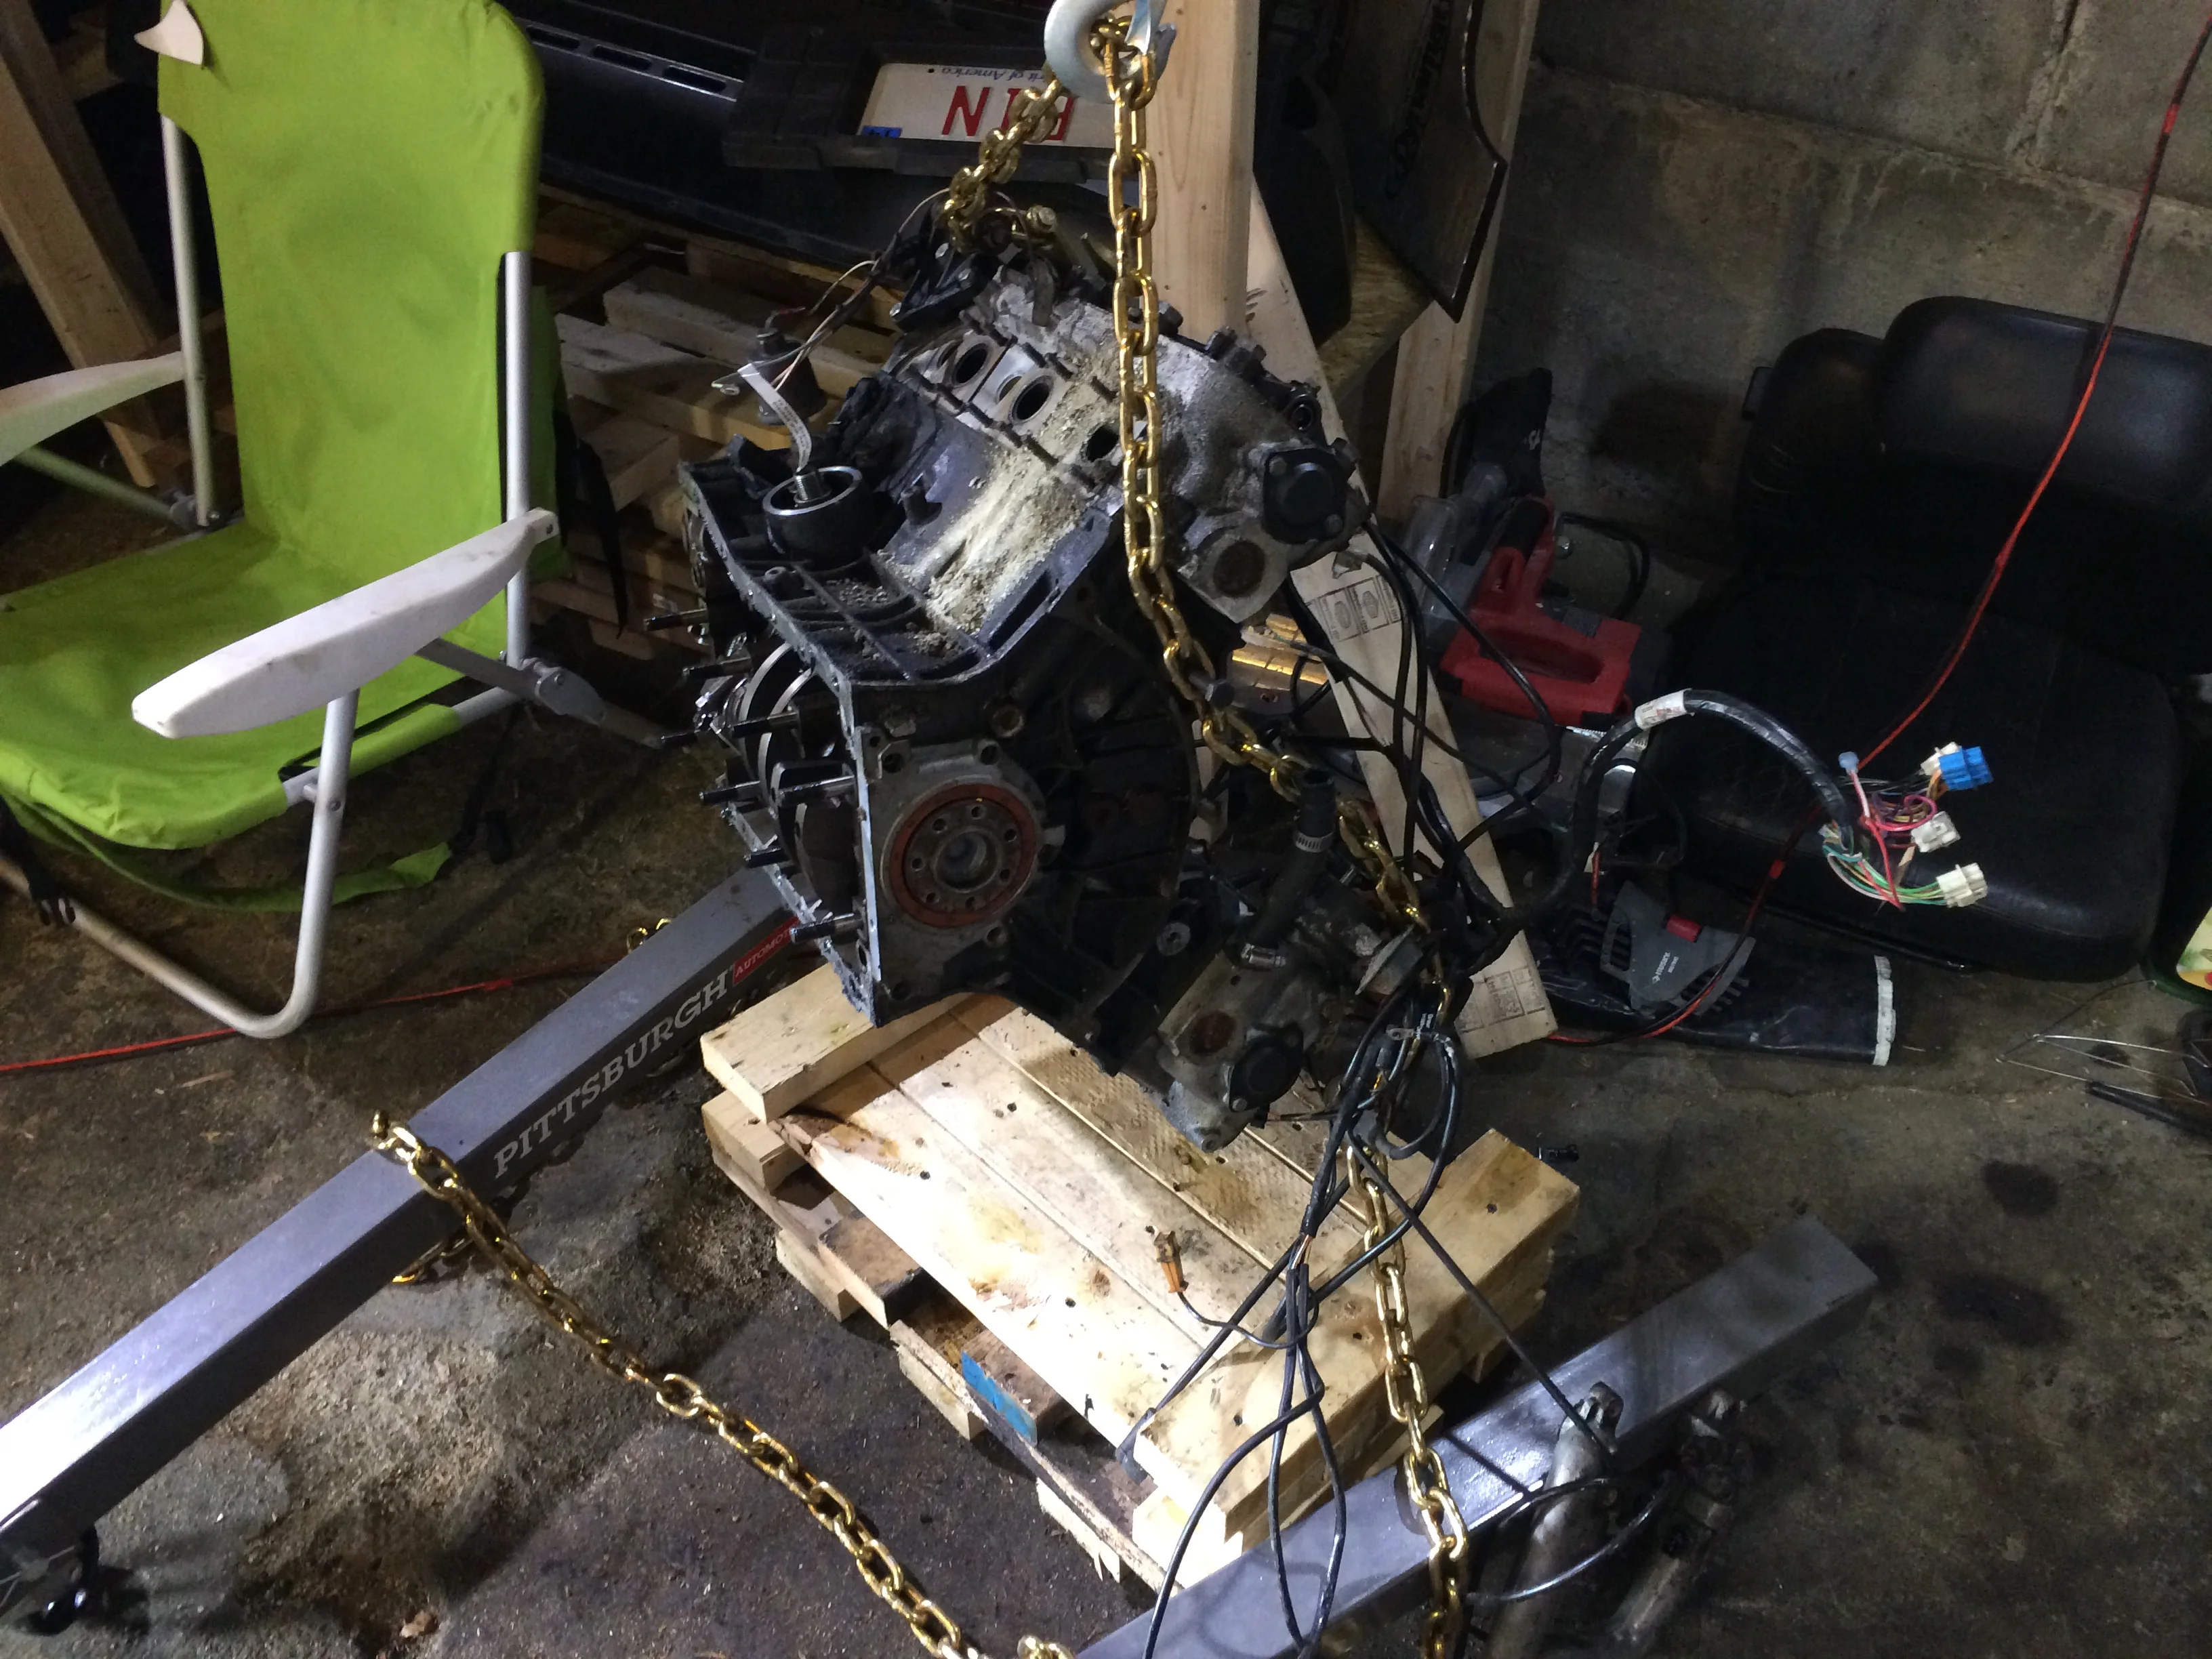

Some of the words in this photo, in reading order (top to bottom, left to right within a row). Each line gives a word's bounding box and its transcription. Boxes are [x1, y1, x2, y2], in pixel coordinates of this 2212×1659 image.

[941, 68, 1004, 81] America
[1006, 70, 1024, 81] of
[735, 923, 798, 977] AUTOMOT
[493, 970, 730, 1179] PITTSBURGH
